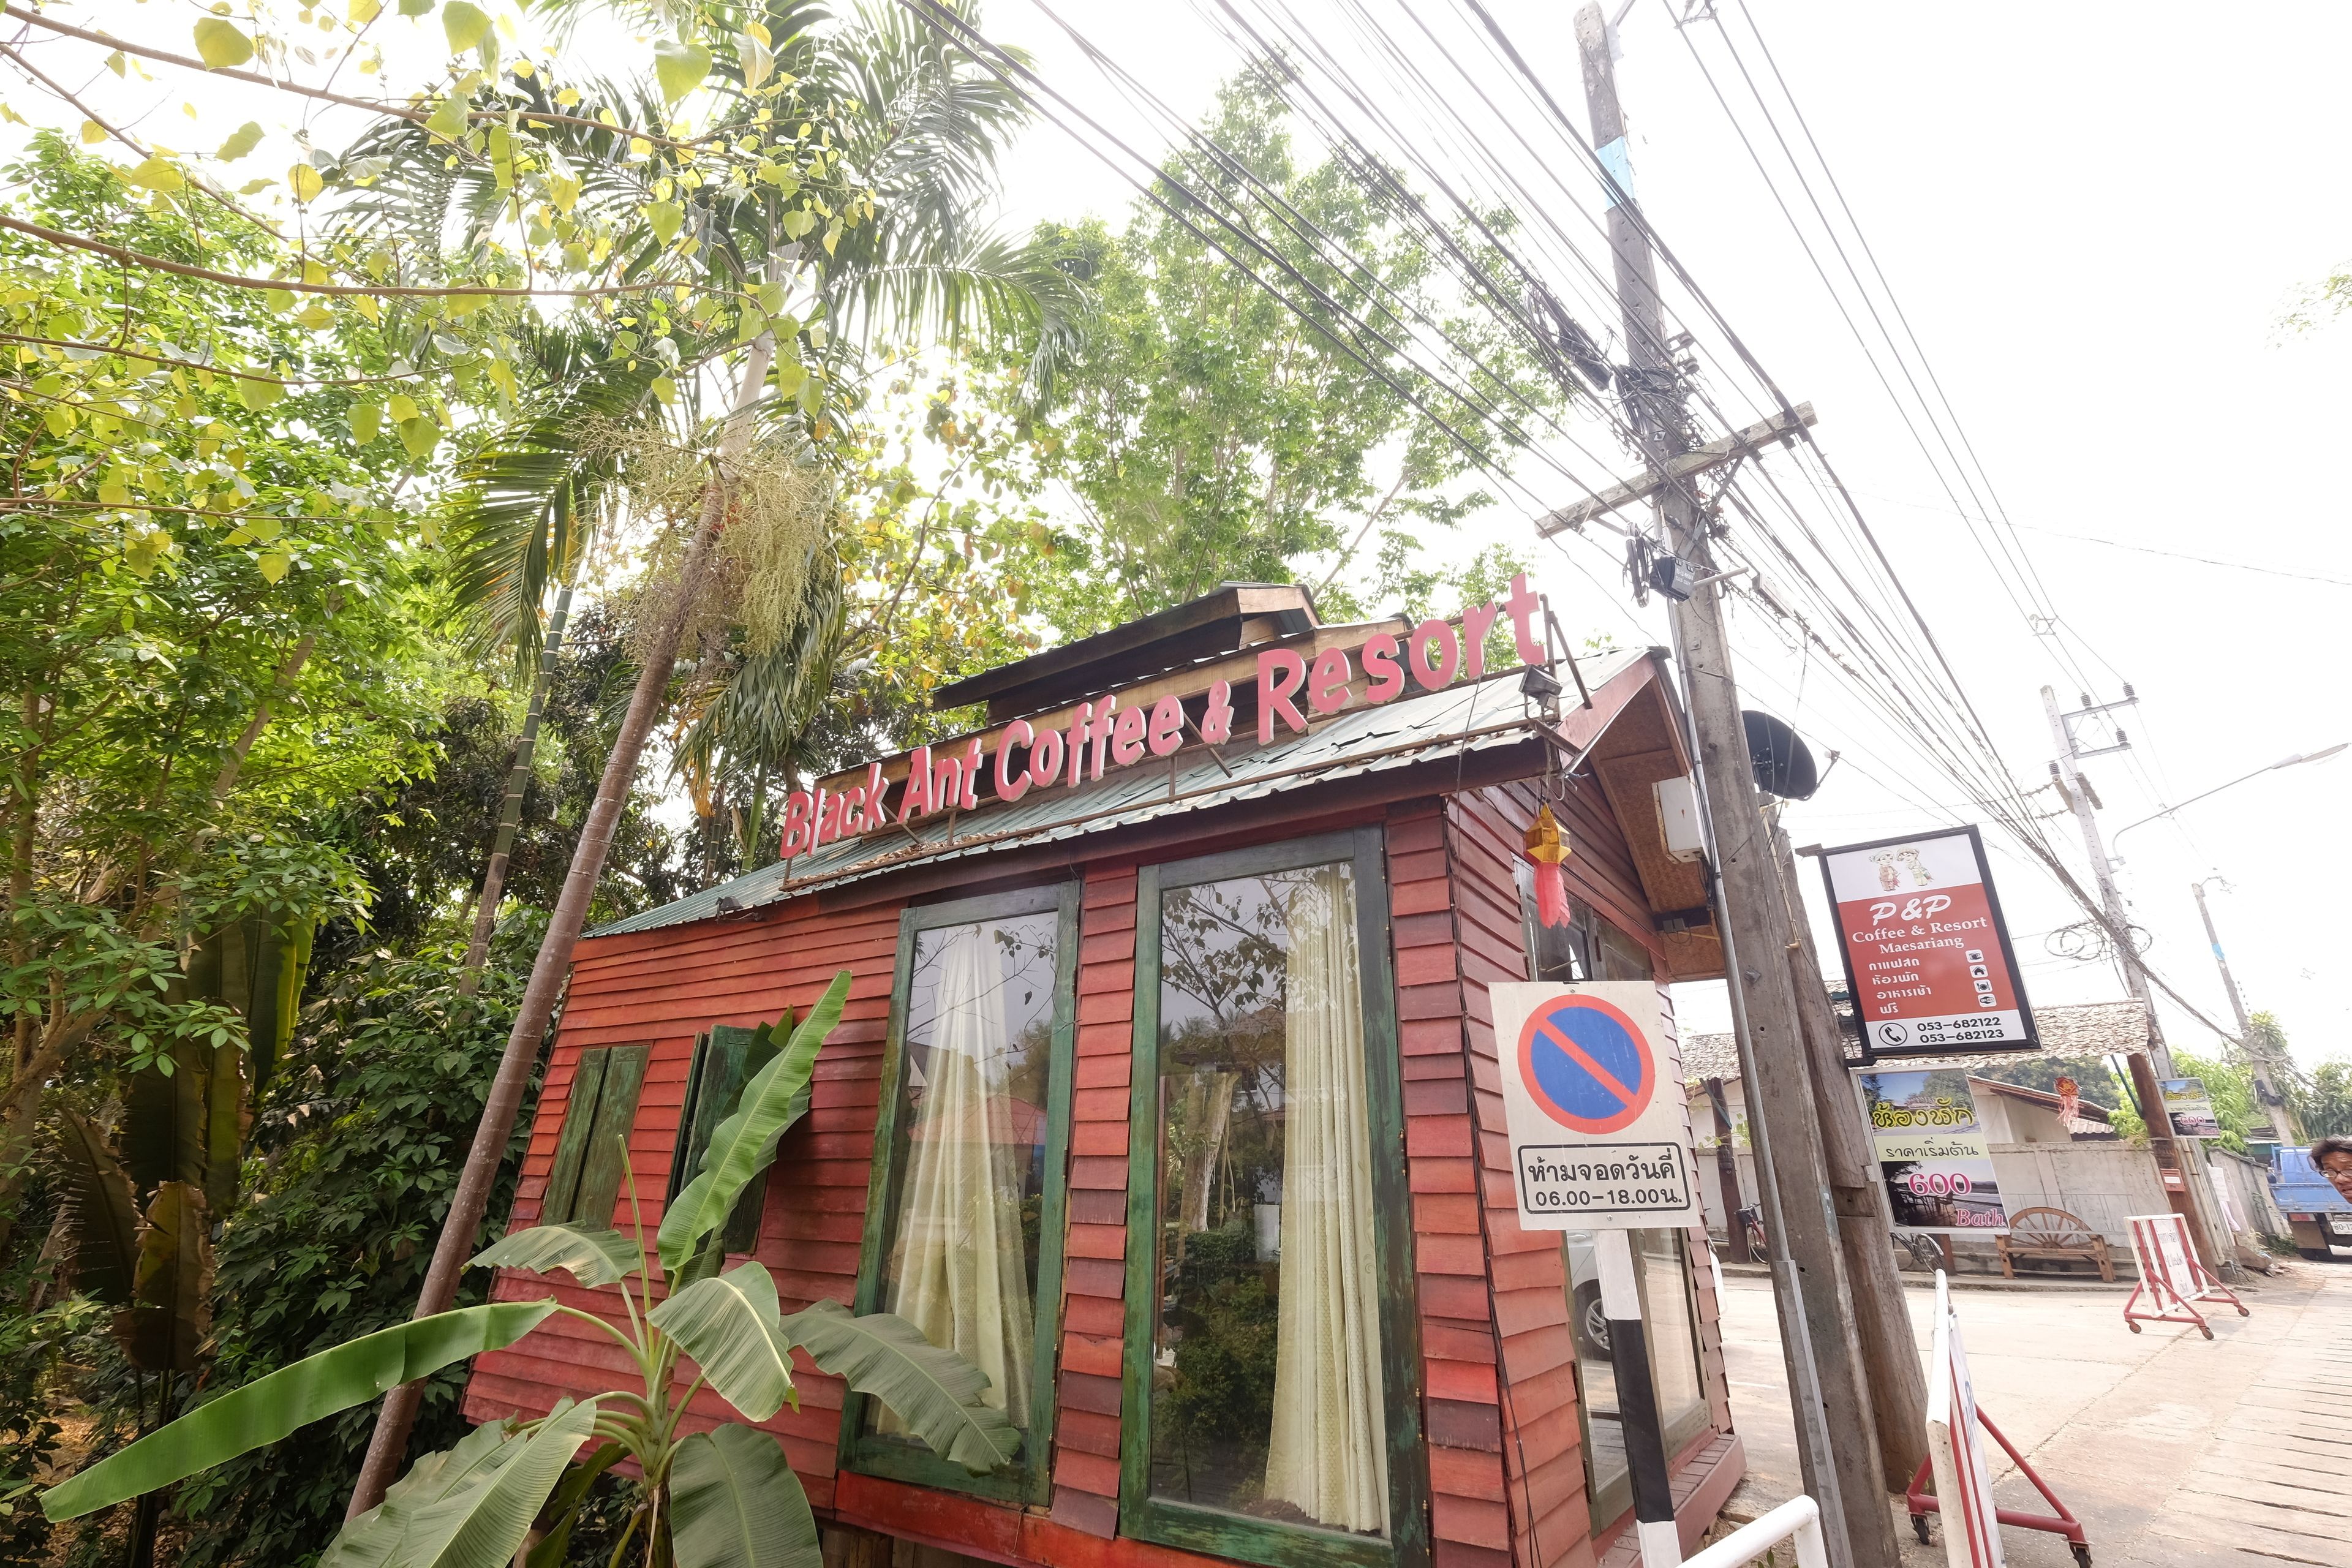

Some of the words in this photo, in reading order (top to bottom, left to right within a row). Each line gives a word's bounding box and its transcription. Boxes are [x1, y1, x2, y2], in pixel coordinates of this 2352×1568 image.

[780, 763, 890, 858] Black
[897, 738, 984, 824] Ant
[994, 695, 1185, 802] Coffee
[1201, 679, 1234, 745] &
[1257, 572, 1548, 745] Resort
[1869, 894, 1951, 926] P&P
[1852, 927, 1905, 943] Coffee
[1910, 925, 1925, 936] &
[1931, 916, 1988, 933] Resort
[1879, 936, 1964, 954] Maesariang
[1869, 958, 1920, 971] กาแฟสด
[1872, 971, 1919, 985] ห้องพัก
[1876, 984, 1932, 1000] อาหารเช้า
[1879, 1002, 1899, 1014] ฟรี
[1917, 1017, 2002, 1031] 053-682122
[1920, 1029, 2005, 1044] 053-682123
[1873, 1097, 1974, 1128] ห้องพัก
[1886, 1137, 1978, 1157] ราคาเริ่มต้น
[1528, 1148, 1676, 1182] ห้ามจอดวันคี่
[1909, 1172, 1972, 1196] 600
[1956, 1208, 2005, 1227] Bath
